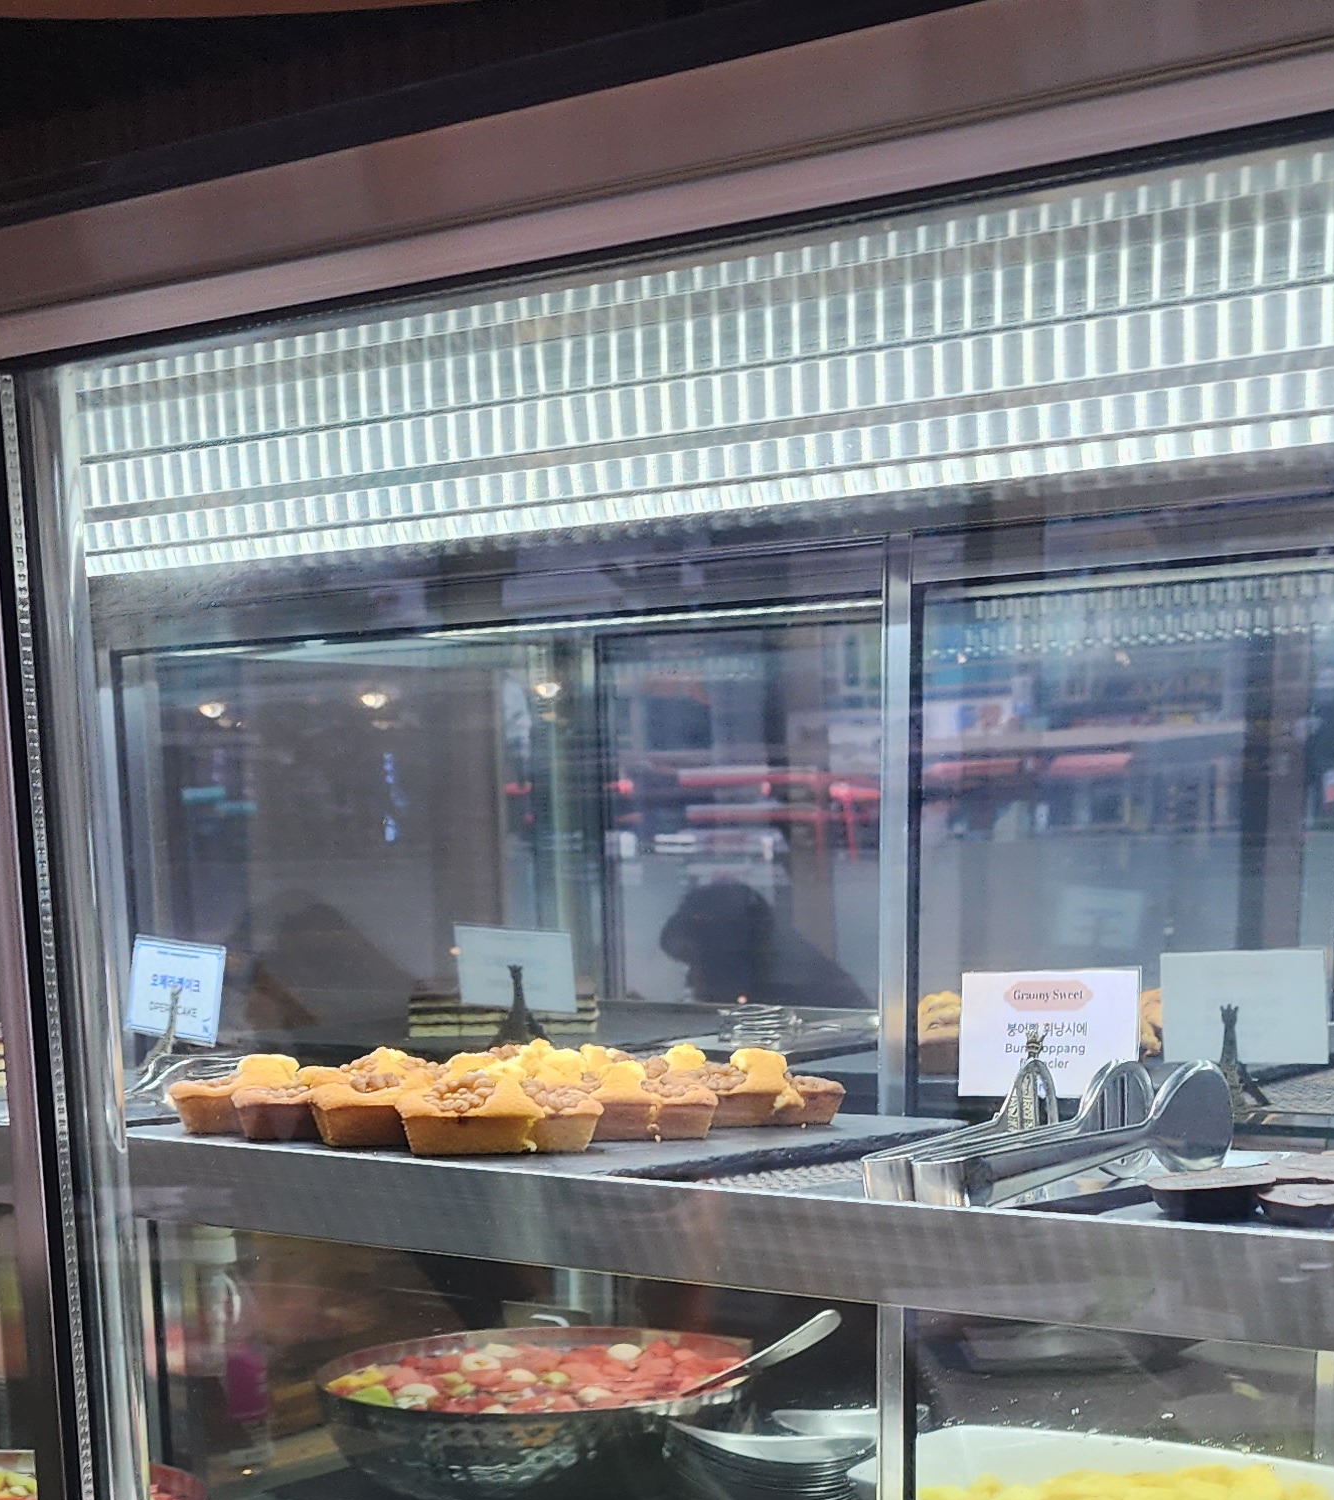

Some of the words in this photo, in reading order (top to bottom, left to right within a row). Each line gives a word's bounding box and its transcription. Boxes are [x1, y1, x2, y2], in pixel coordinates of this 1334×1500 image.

[1013, 989, 1051, 1003] Granny
[1053, 989, 1084, 1000] Sweet
[1005, 1043, 1086, 1056] Bunoppang
